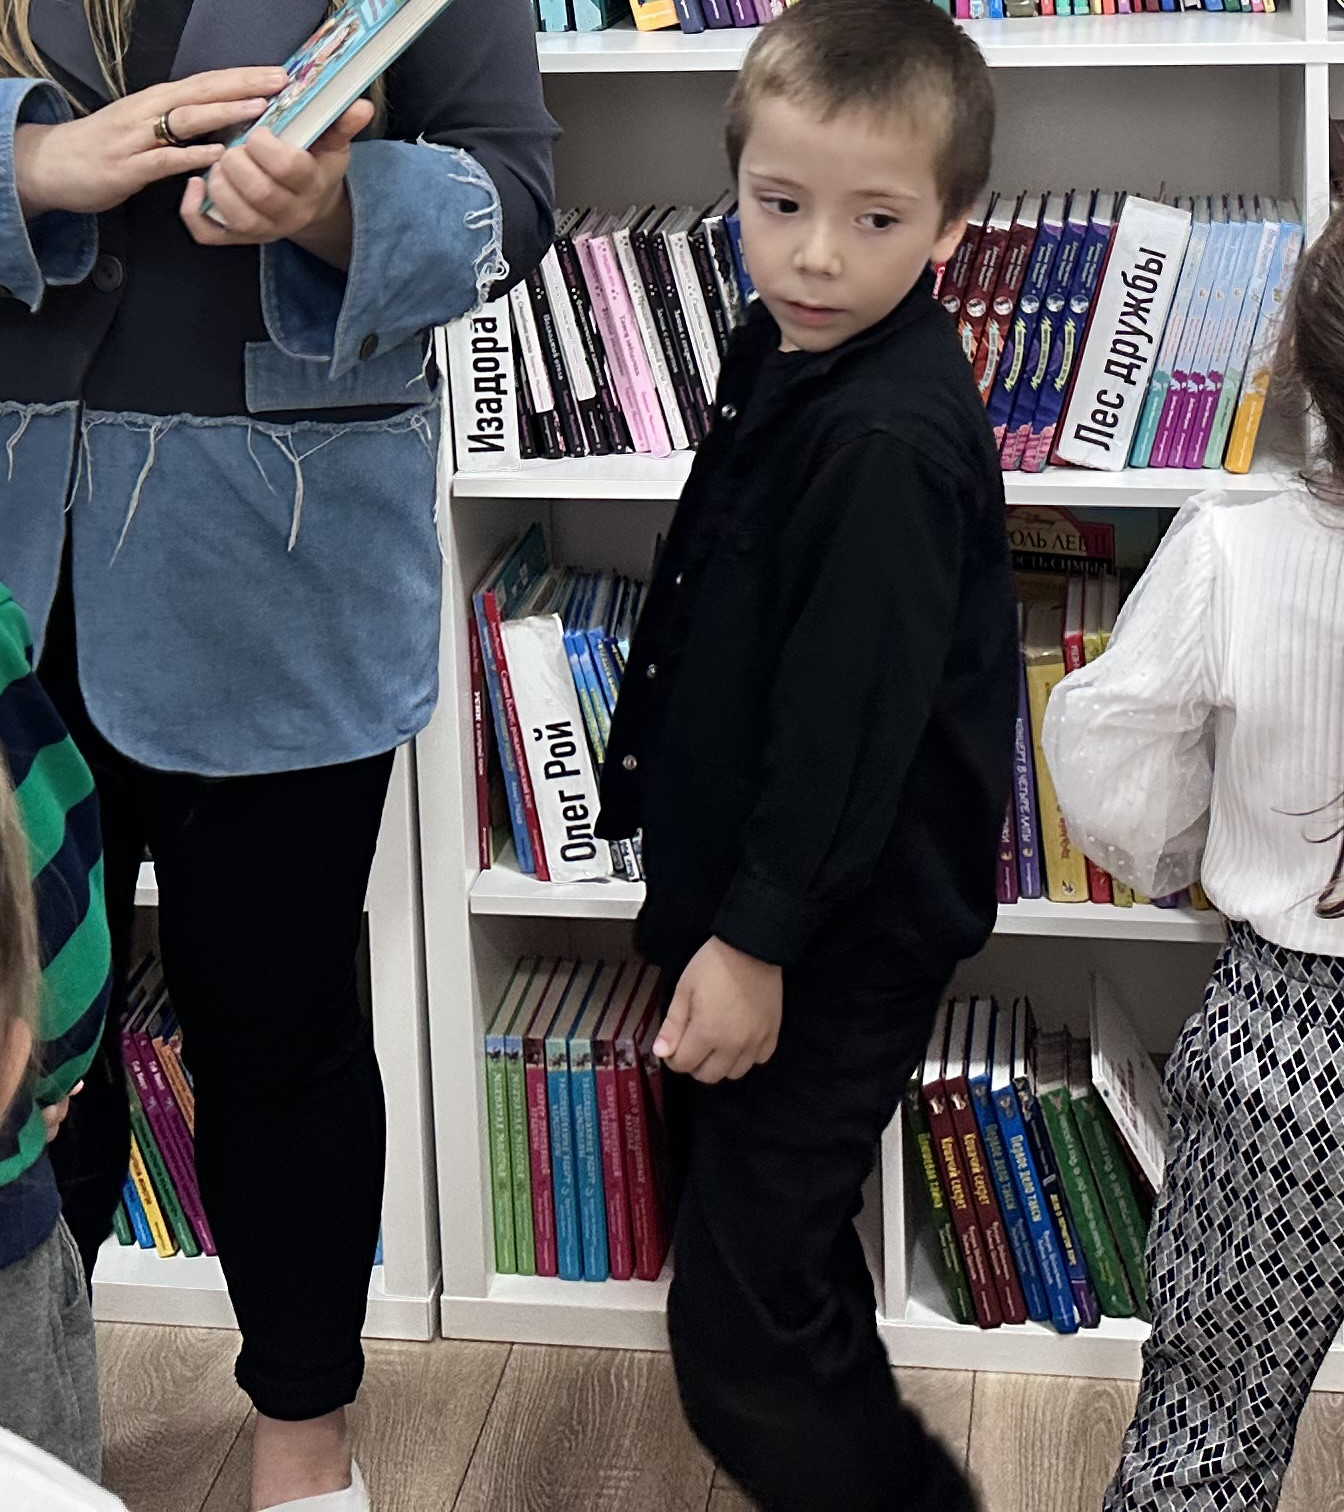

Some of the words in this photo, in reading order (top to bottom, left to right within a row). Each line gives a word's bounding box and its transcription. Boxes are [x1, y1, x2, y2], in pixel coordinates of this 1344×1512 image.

[1074, 390, 1125, 451] Лес
[1103, 247, 1167, 386] дружбы
[467, 318, 508, 453] Изадора
[532, 721, 582, 780] Рой
[558, 790, 597, 862] Олег
[941, 1138, 961, 1176] Кошачий
[950, 1180, 970, 1209] секрет
